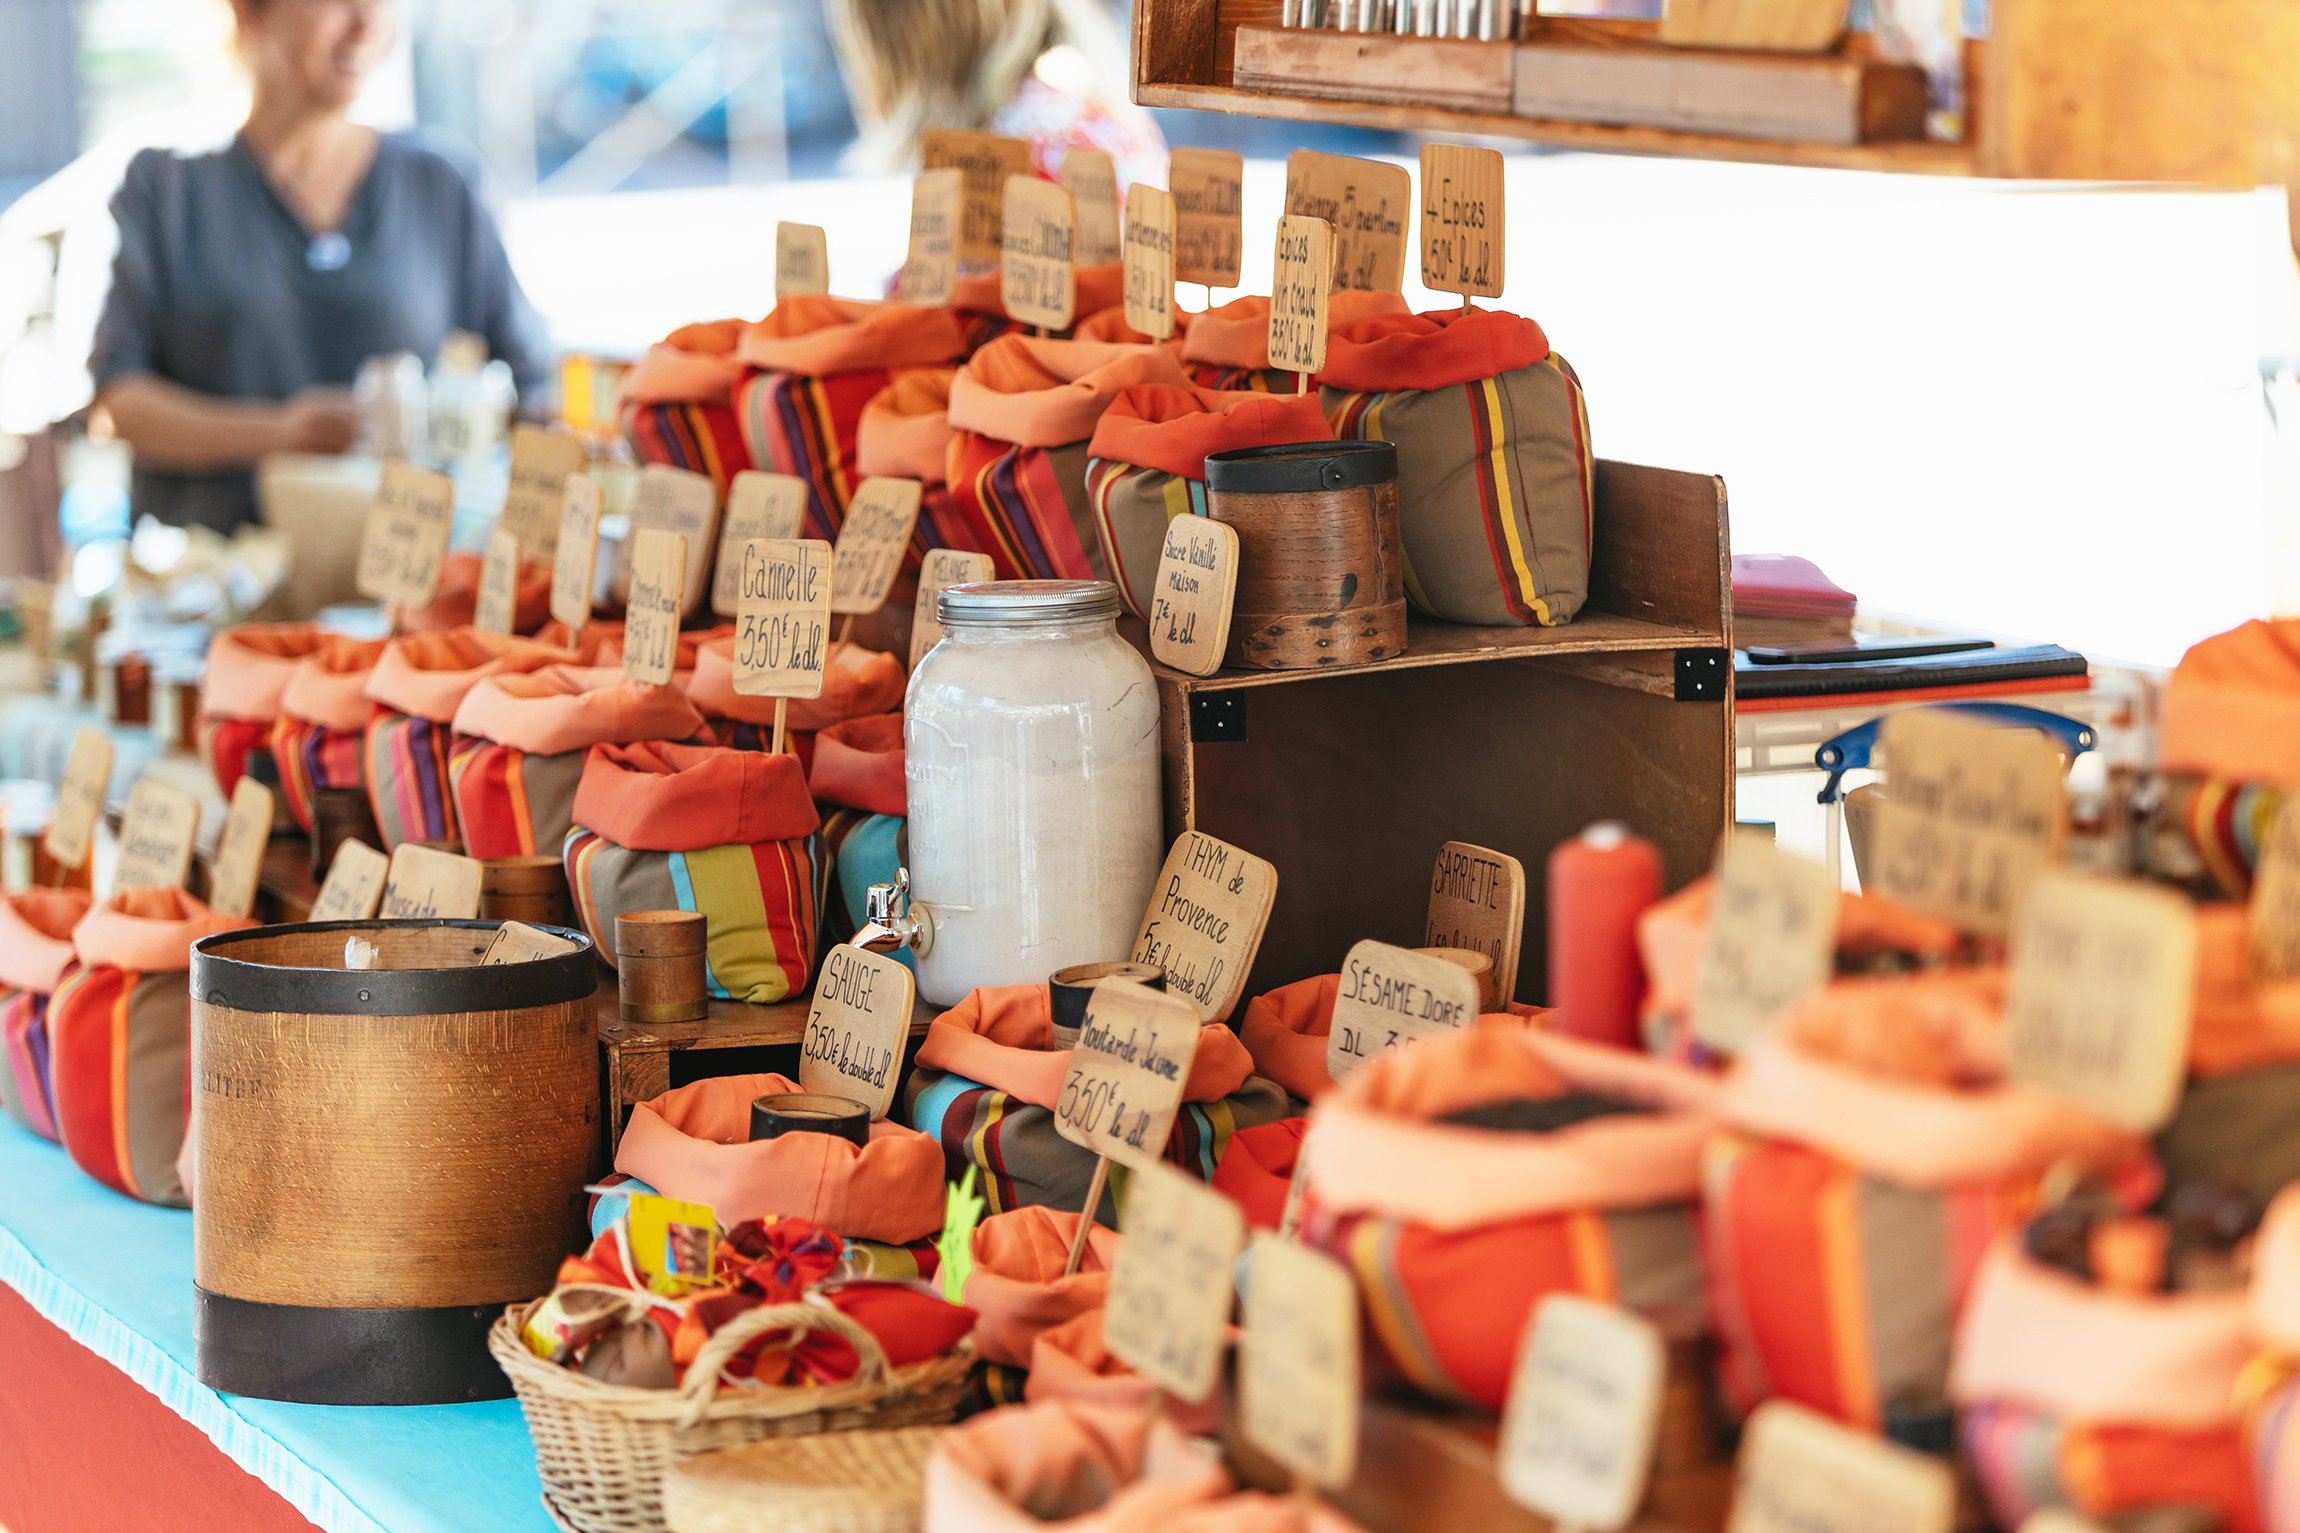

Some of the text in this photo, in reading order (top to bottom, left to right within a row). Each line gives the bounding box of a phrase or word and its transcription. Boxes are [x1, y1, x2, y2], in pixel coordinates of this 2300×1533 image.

[743, 543, 818, 603] Cannelle
[1164, 530, 1187, 562] Sucre
[739, 613, 790, 671] 3,50€
[786, 621, 802, 670] le
[1152, 598, 1170, 636] 7€
[1183, 833, 1245, 895] THYM de
[1434, 848, 1502, 910] SARRIETTE
[1161, 874, 1230, 944] Provence
[822, 952, 881, 1013] SAUGE
[1166, 953, 1196, 996] double
[1195, 956, 1224, 1007] dl
[805, 1011, 892, 1089] 3,50€ le double dl
[1078, 1011, 1181, 1081] Moutarde Jaune
[1337, 1027, 1365, 1058] DL
[1059, 1069, 1120, 1133] 3,50€
[1107, 1101, 1127, 1139] le
